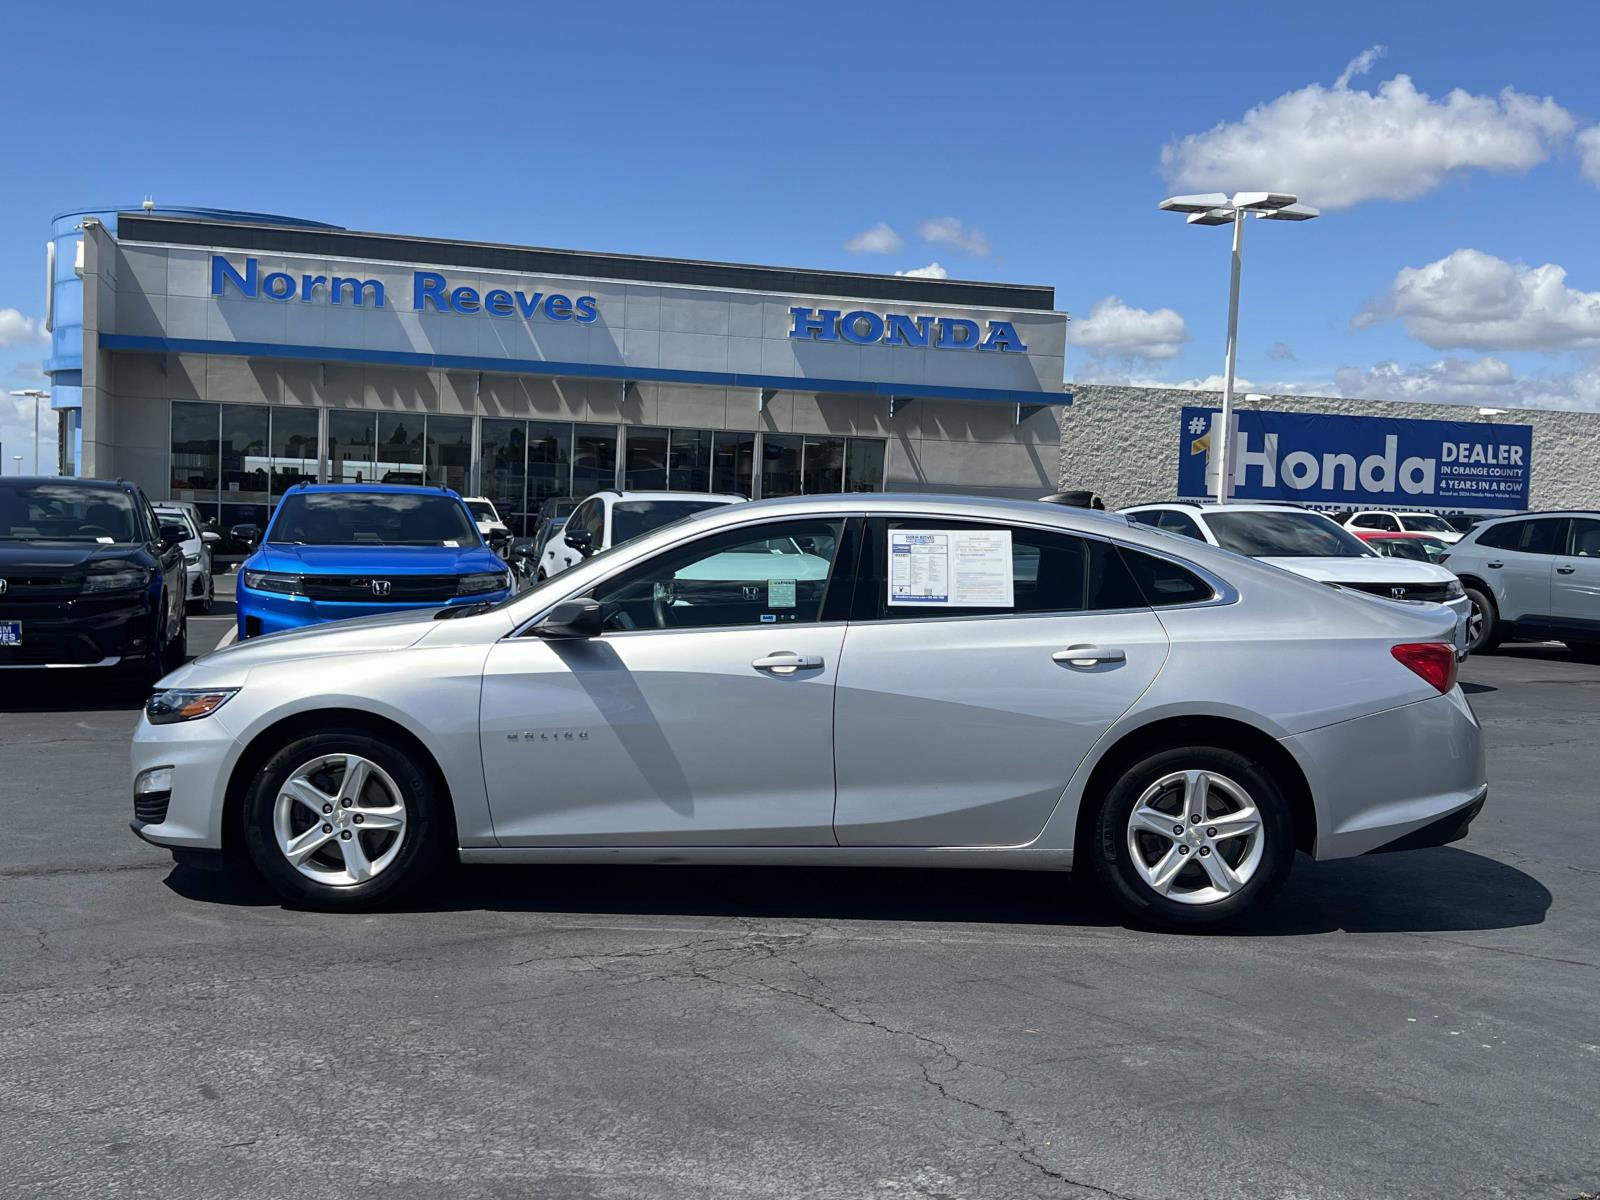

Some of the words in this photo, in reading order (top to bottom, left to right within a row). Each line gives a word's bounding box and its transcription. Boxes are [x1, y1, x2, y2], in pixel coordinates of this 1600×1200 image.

[211, 255, 386, 308] Norm
[413, 271, 598, 324] Reeves
[788, 306, 1028, 353] HONDA
[1234, 431, 1437, 495] Honda
[1440, 465, 1451, 474] IN
[1452, 466, 1488, 476] ORANGE
[1489, 468, 1524, 477] COUNTY
[1441, 442, 1524, 466] DEALER
[1440, 480, 1447, 489] 4
[1448, 480, 1477, 490] YEARS
[1479, 481, 1490, 491] IN
[1490, 482, 1498, 491] A
[1500, 483, 1523, 492] ROW
